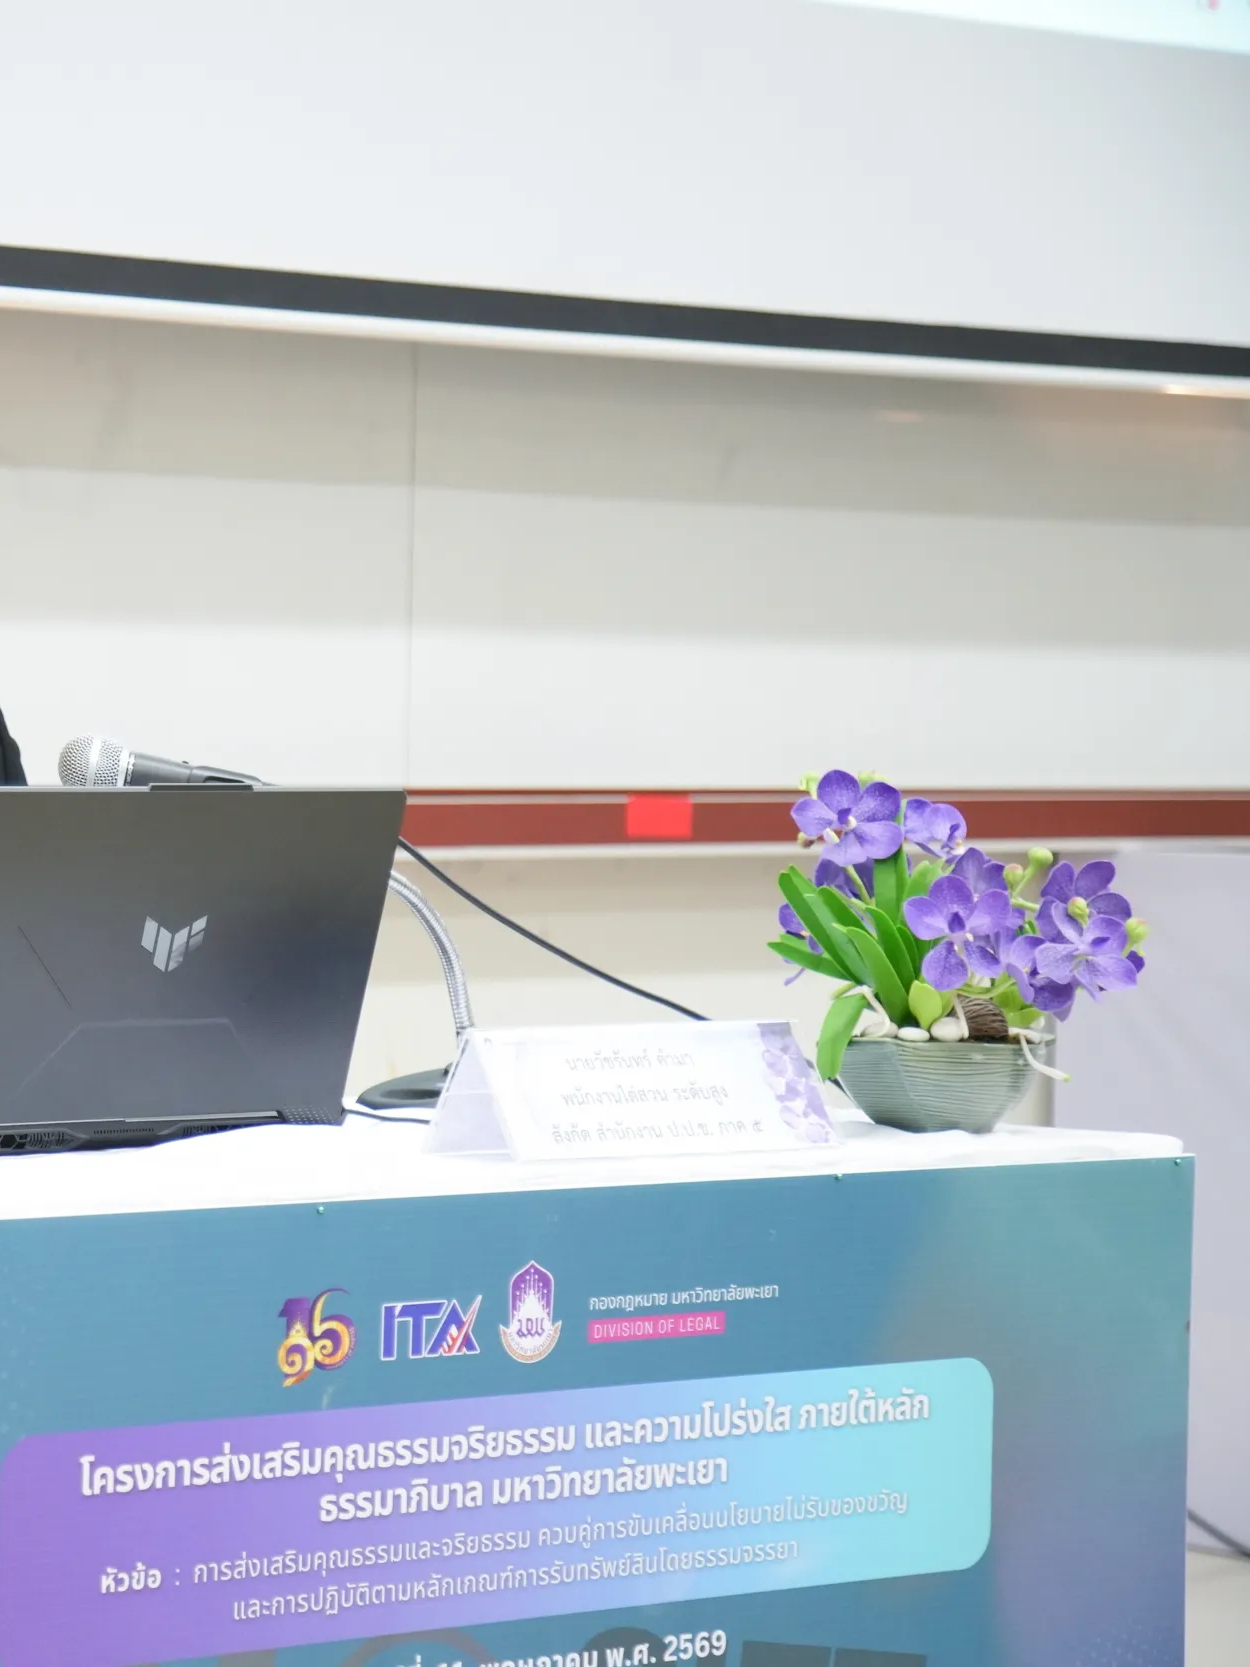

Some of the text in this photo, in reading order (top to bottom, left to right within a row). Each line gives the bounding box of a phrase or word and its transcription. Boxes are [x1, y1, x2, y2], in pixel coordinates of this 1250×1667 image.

[560, 1080, 730, 1107] พนักงานไต่สวน ระดับสูง
[551, 1122, 592, 1145] สังกัด
[596, 1121, 663, 1141] สำนักงาน
[718, 1120, 748, 1135] ภาค
[589, 1284, 779, 1312] กองกฎหมาย มหาวิทยาลัยพะเยา
[593, 1315, 721, 1340] DIVISION OF LEGAL
[79, 1387, 931, 1497] โครงการส่งเสริมคุณธรรมจริยธรรม และความโปร่งใส ภายใต้หลัก
[319, 1456, 728, 1523] ธรรมาภิบาล มหาวิทยาลัยพะเยา
[100, 1561, 162, 1595] หัวข้อ
[193, 1529, 531, 1584] การส่งเสริมคุณธรรมและจริยธรรม
[538, 1488, 908, 1553] ควบคู่การขับเคลื่อนนโยบายไม่รับของขวัญ
[233, 1539, 798, 1621] และการปฏิบัติตามหลักเกณฑ์การรับทรัพย์สินโดยธรรมจรรยา
[605, 1641, 657, 1667] พ.ศ.
[662, 1629, 727, 1663] 2569
